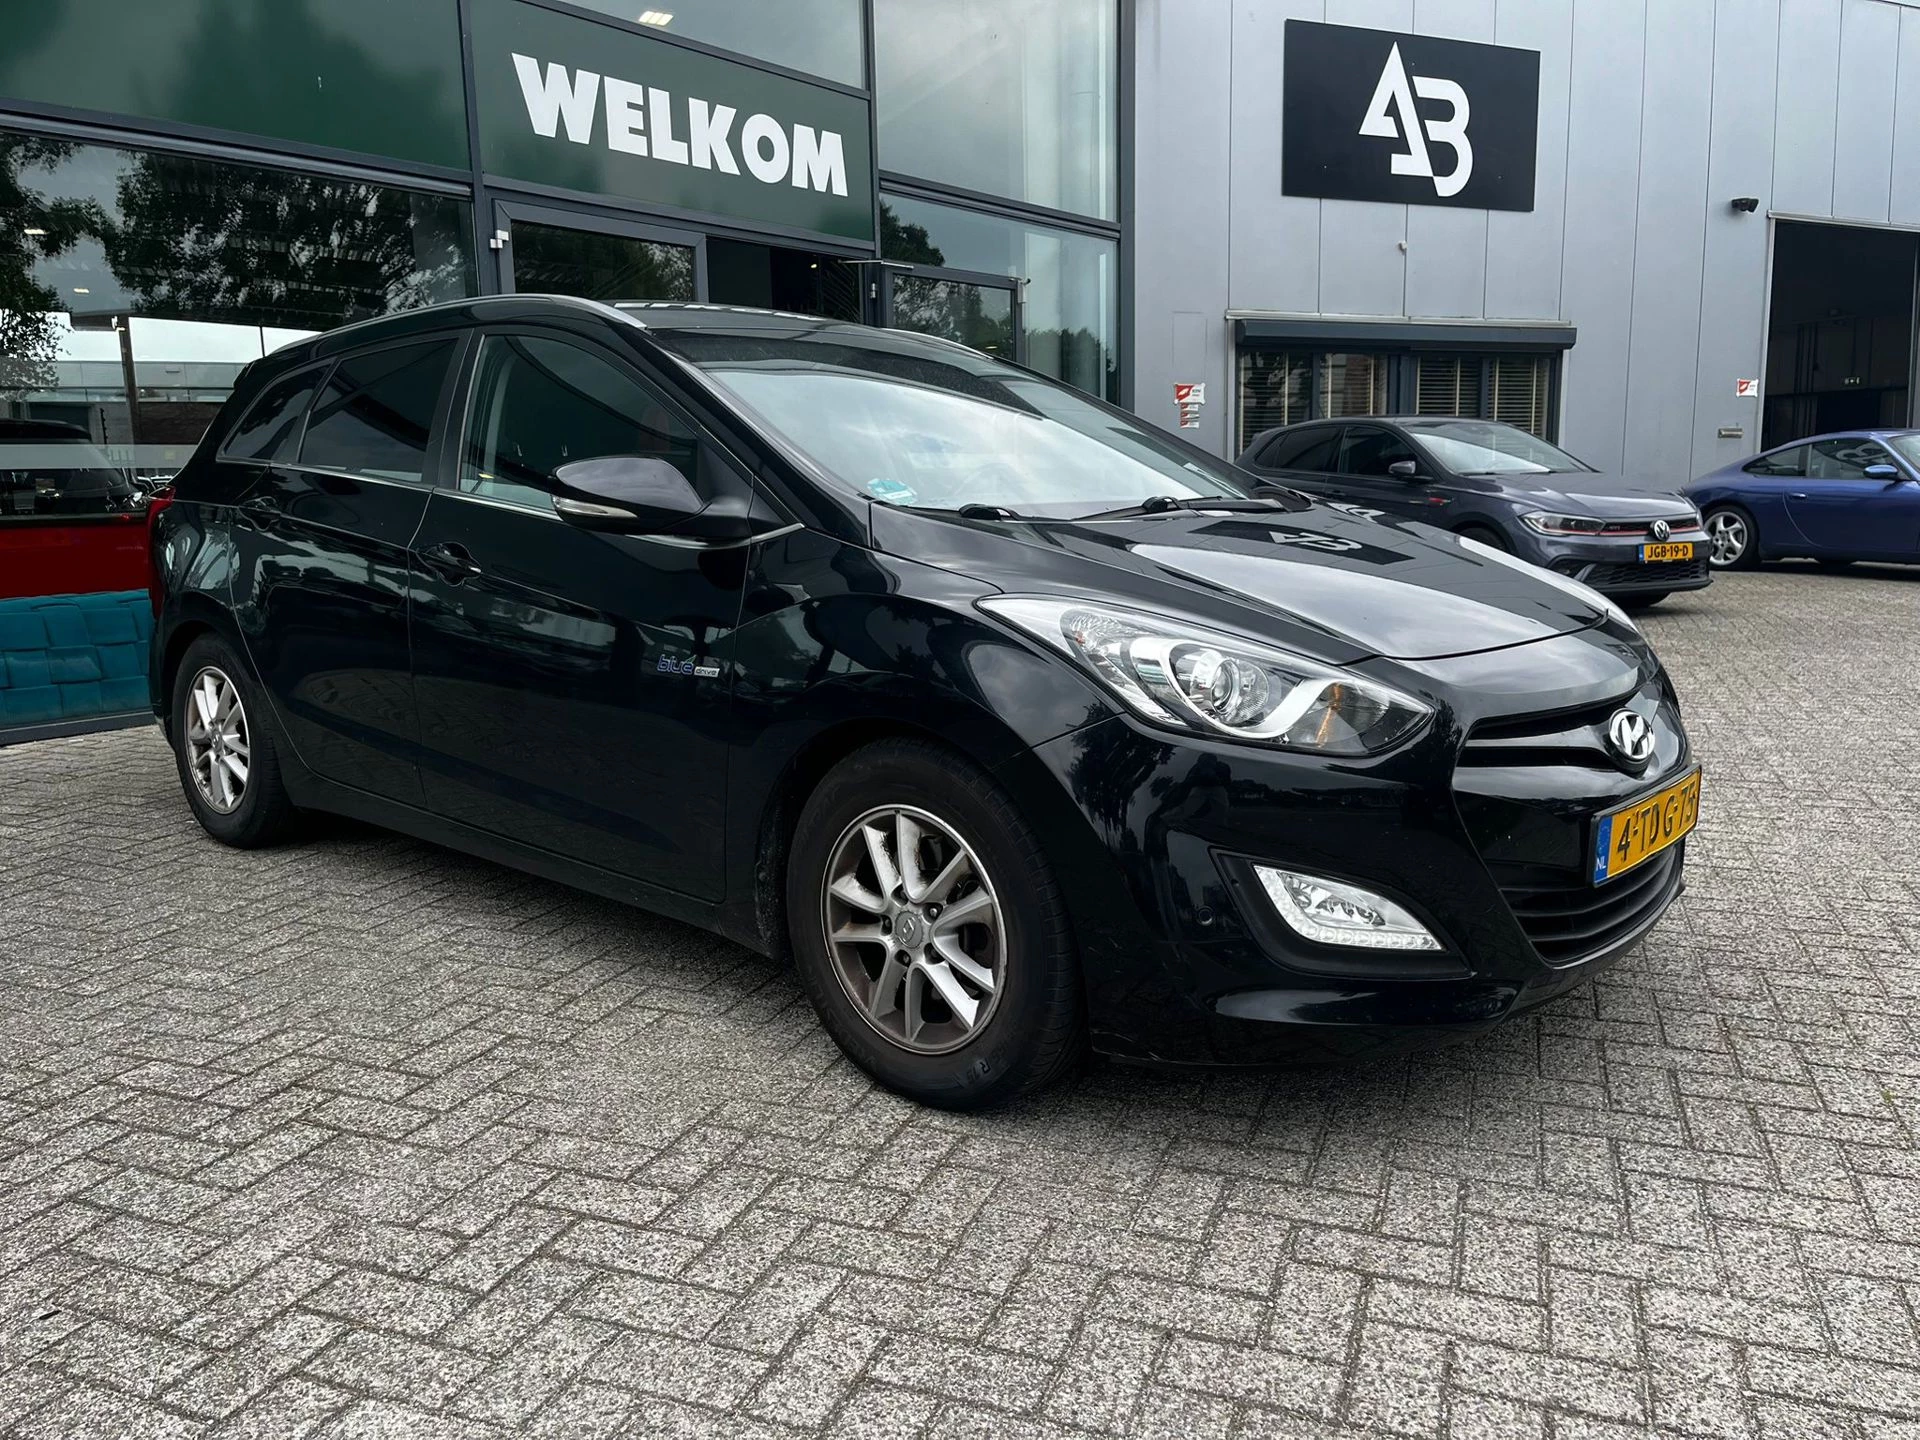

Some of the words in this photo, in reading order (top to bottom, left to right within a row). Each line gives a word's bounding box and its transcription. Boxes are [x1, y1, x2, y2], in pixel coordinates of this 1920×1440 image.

[511, 52, 848, 197] WELKOM
[1359, 41, 1473, 197] AB
[1648, 545, 1689, 559] JGB-19-D
[657, 654, 695, 675] blue
[695, 667, 718, 676] drive
[1595, 856, 1607, 871] NL
